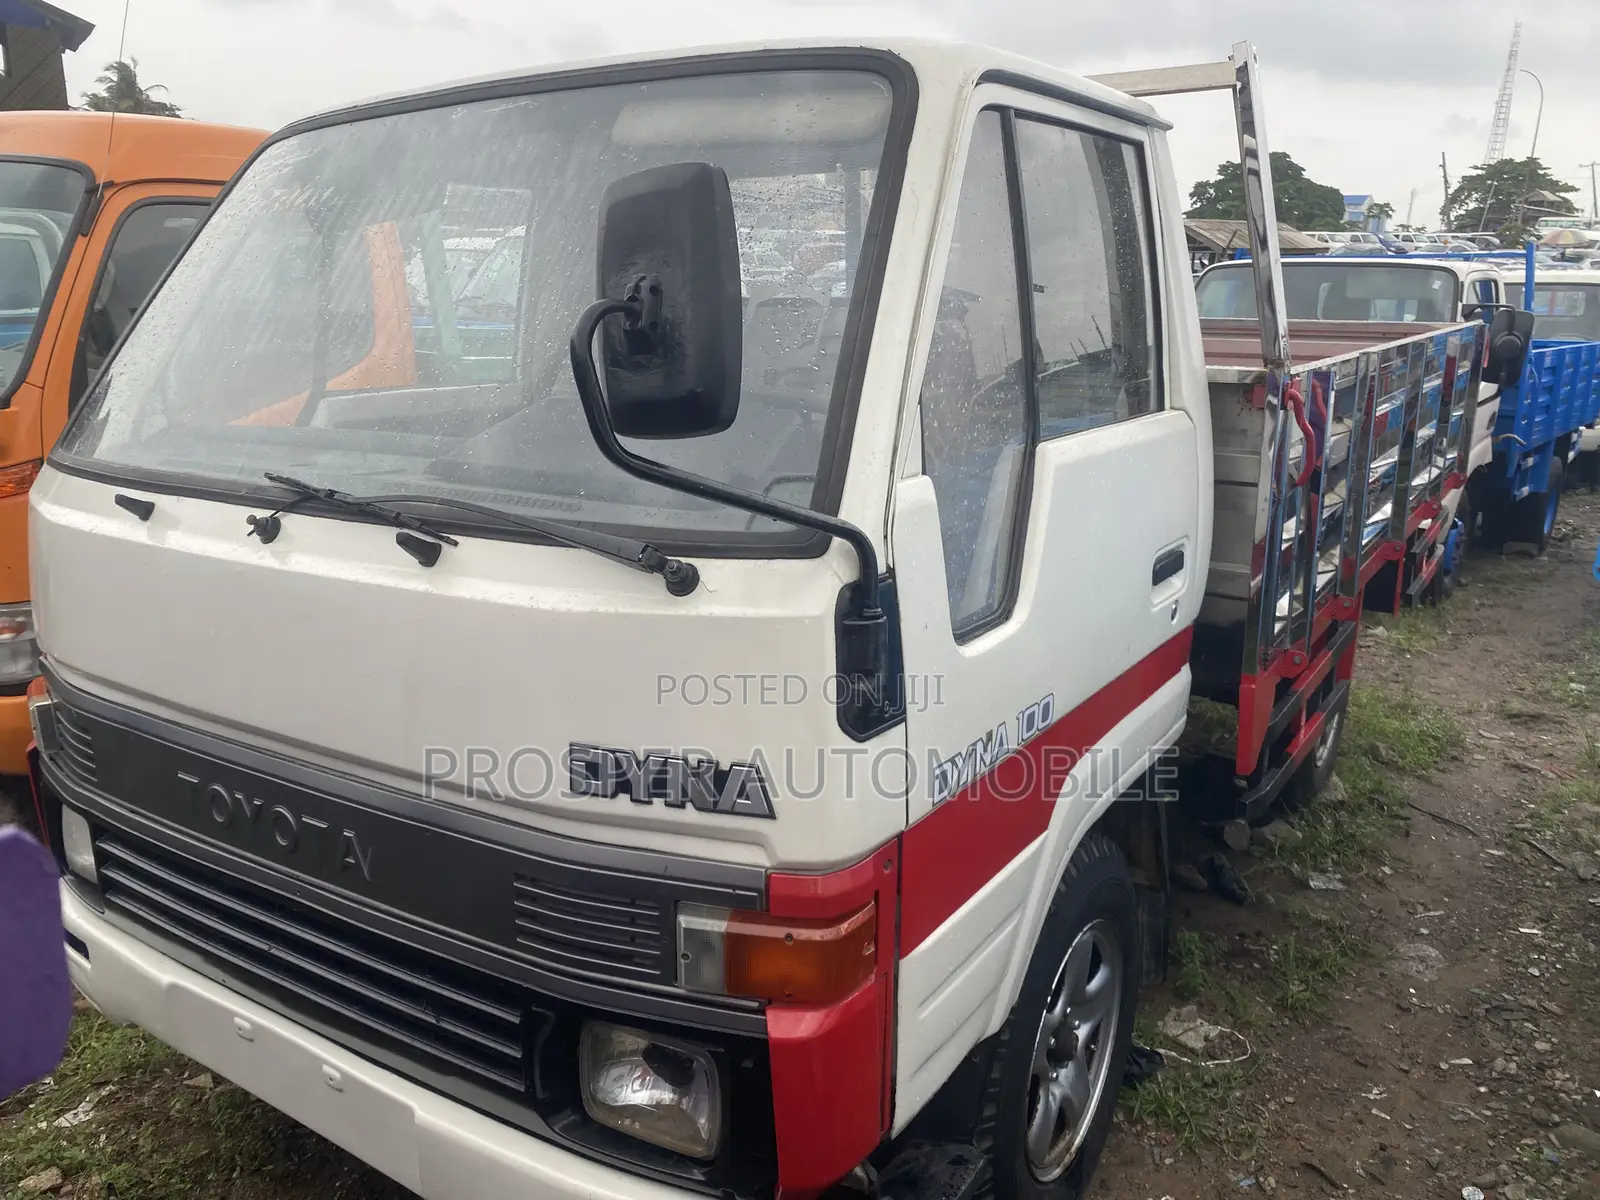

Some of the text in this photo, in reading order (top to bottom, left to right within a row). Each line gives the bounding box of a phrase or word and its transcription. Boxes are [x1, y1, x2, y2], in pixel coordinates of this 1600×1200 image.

[569, 742, 776, 820] DYNA
[932, 693, 1055, 807] DYNA 100
[177, 770, 373, 882] TOYOTA
